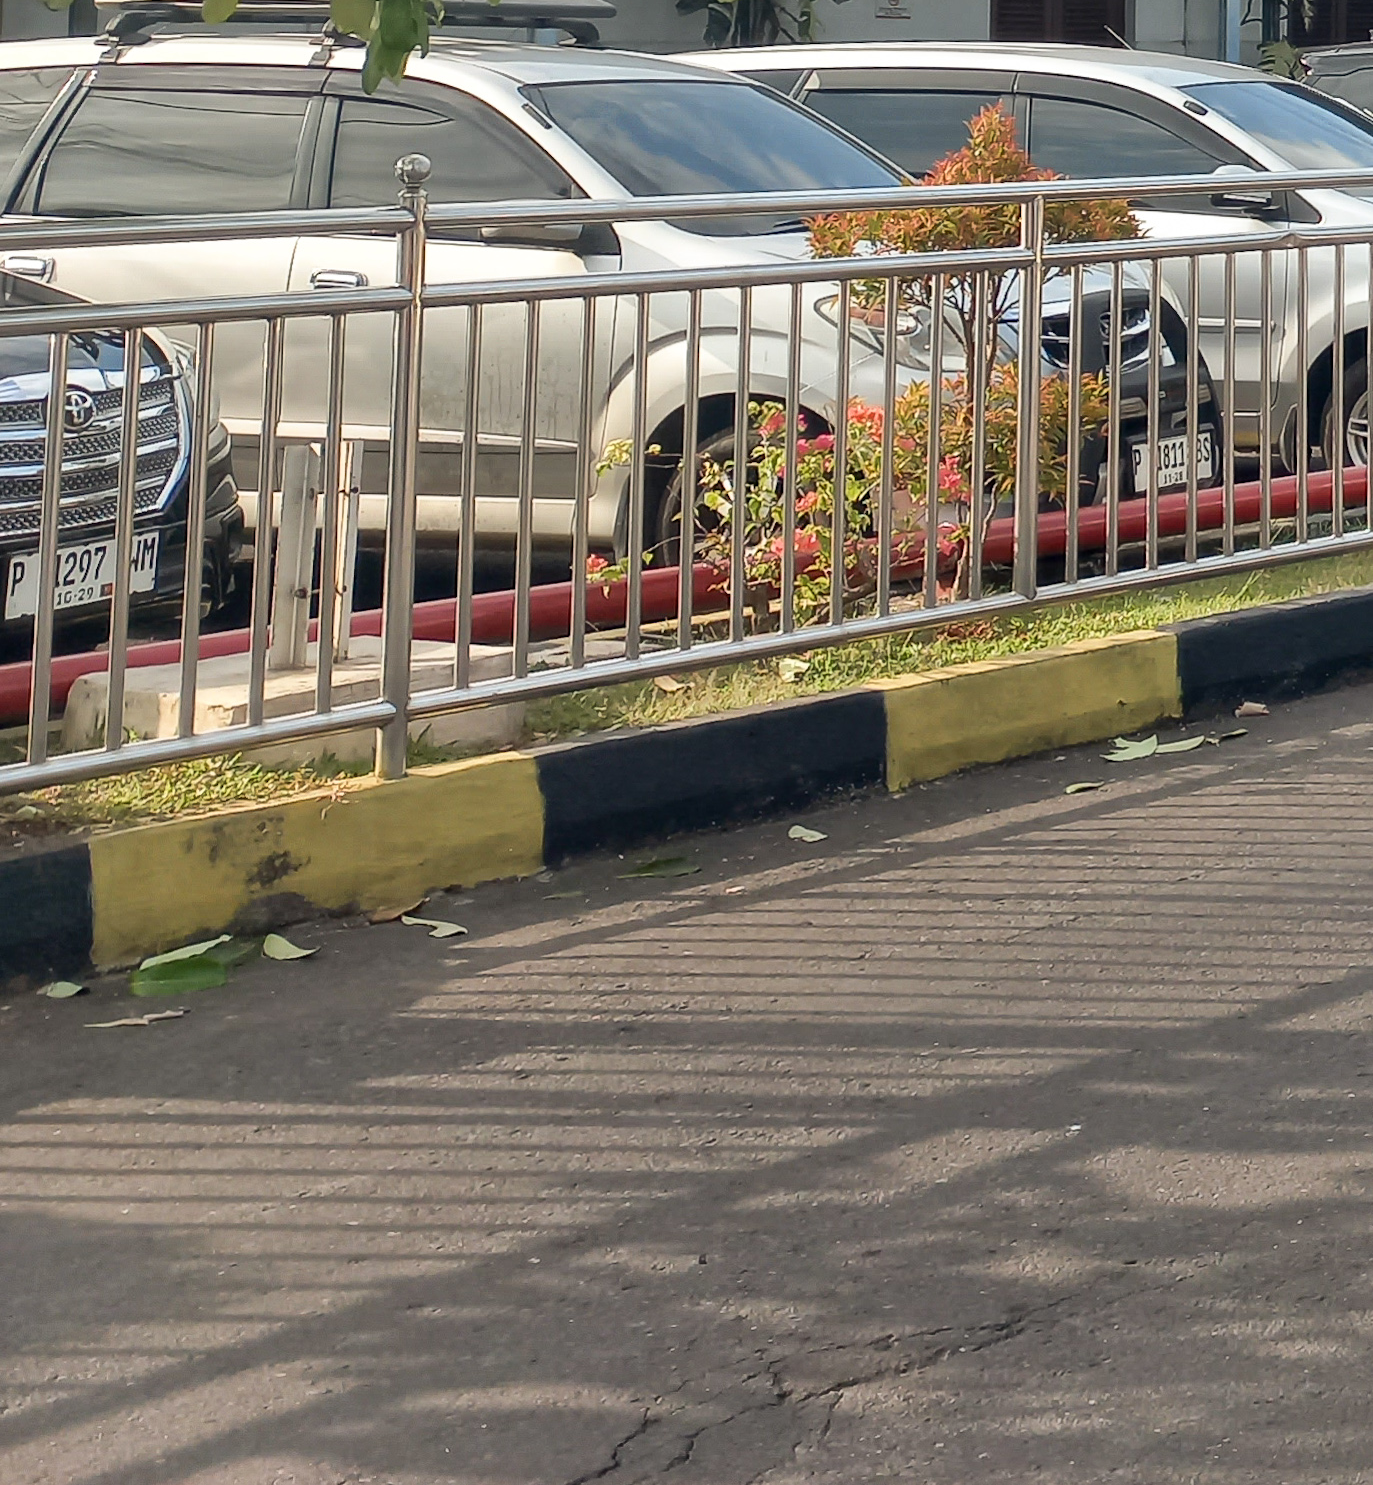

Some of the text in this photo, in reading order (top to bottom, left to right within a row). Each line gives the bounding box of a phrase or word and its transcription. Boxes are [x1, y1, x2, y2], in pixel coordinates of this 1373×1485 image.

[1133, 449, 1142, 475] P
[10, 561, 25, 597] P
[54, 545, 107, 588] 1297
